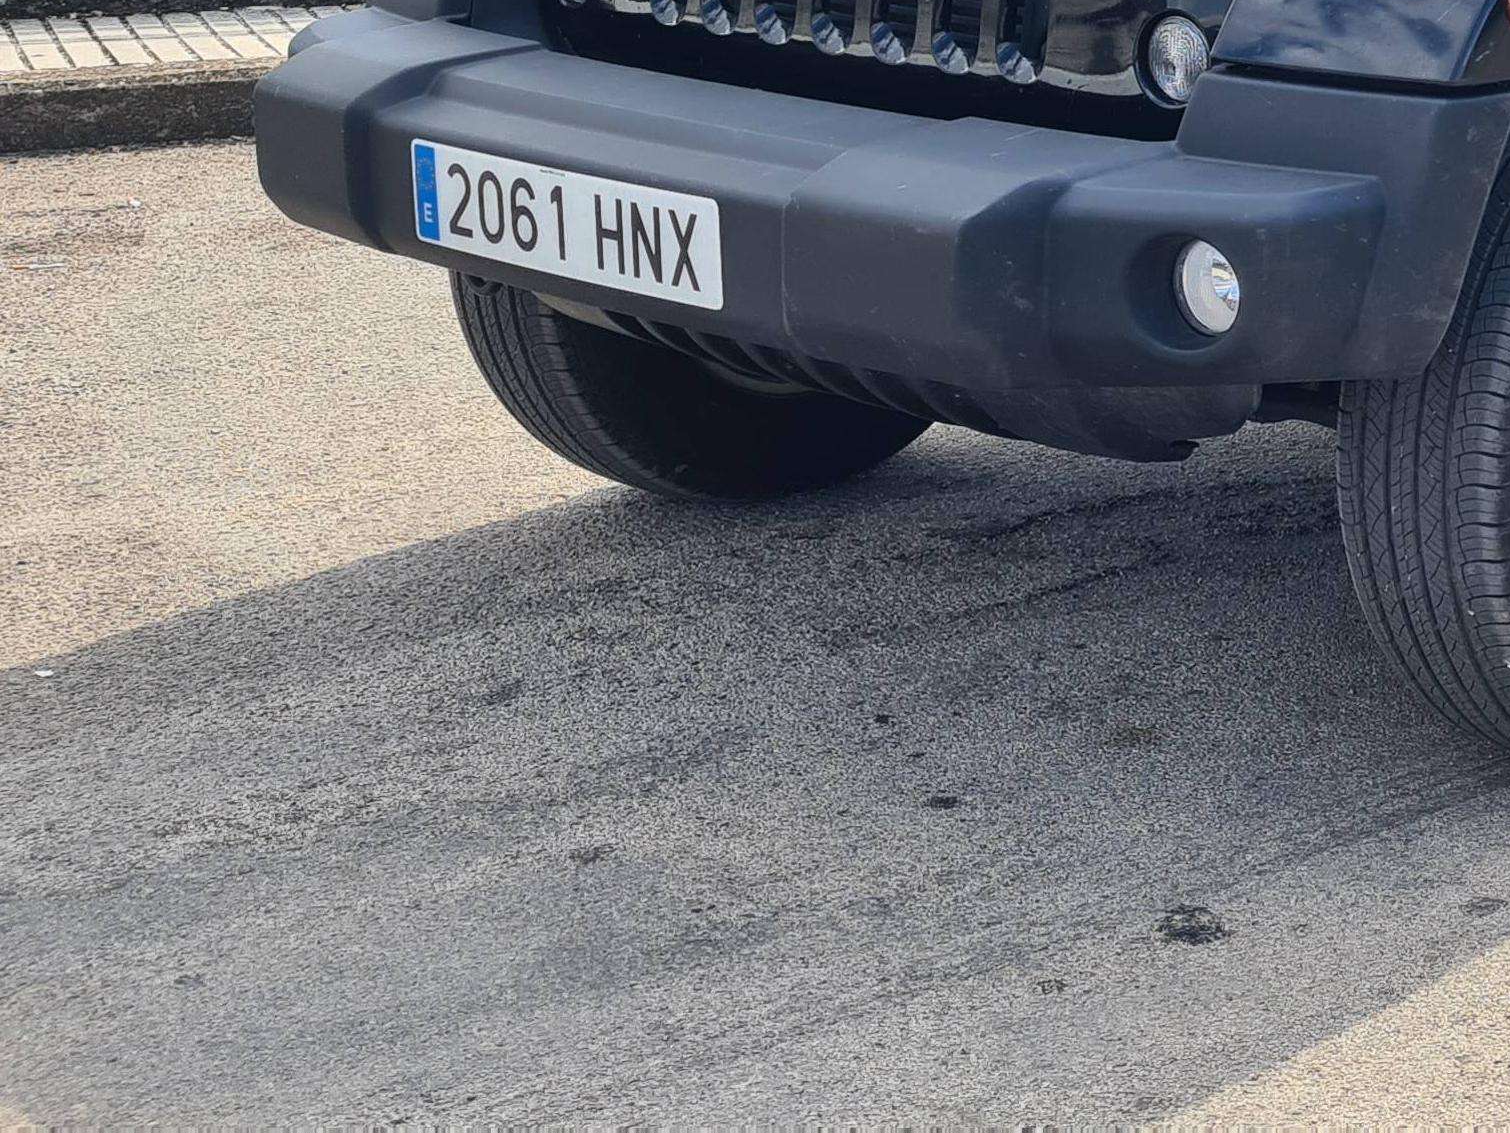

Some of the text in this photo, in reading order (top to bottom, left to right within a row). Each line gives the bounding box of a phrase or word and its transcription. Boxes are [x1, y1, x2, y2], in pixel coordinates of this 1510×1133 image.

[423, 202, 434, 223] E
[447, 163, 701, 292] 2061 HNX
